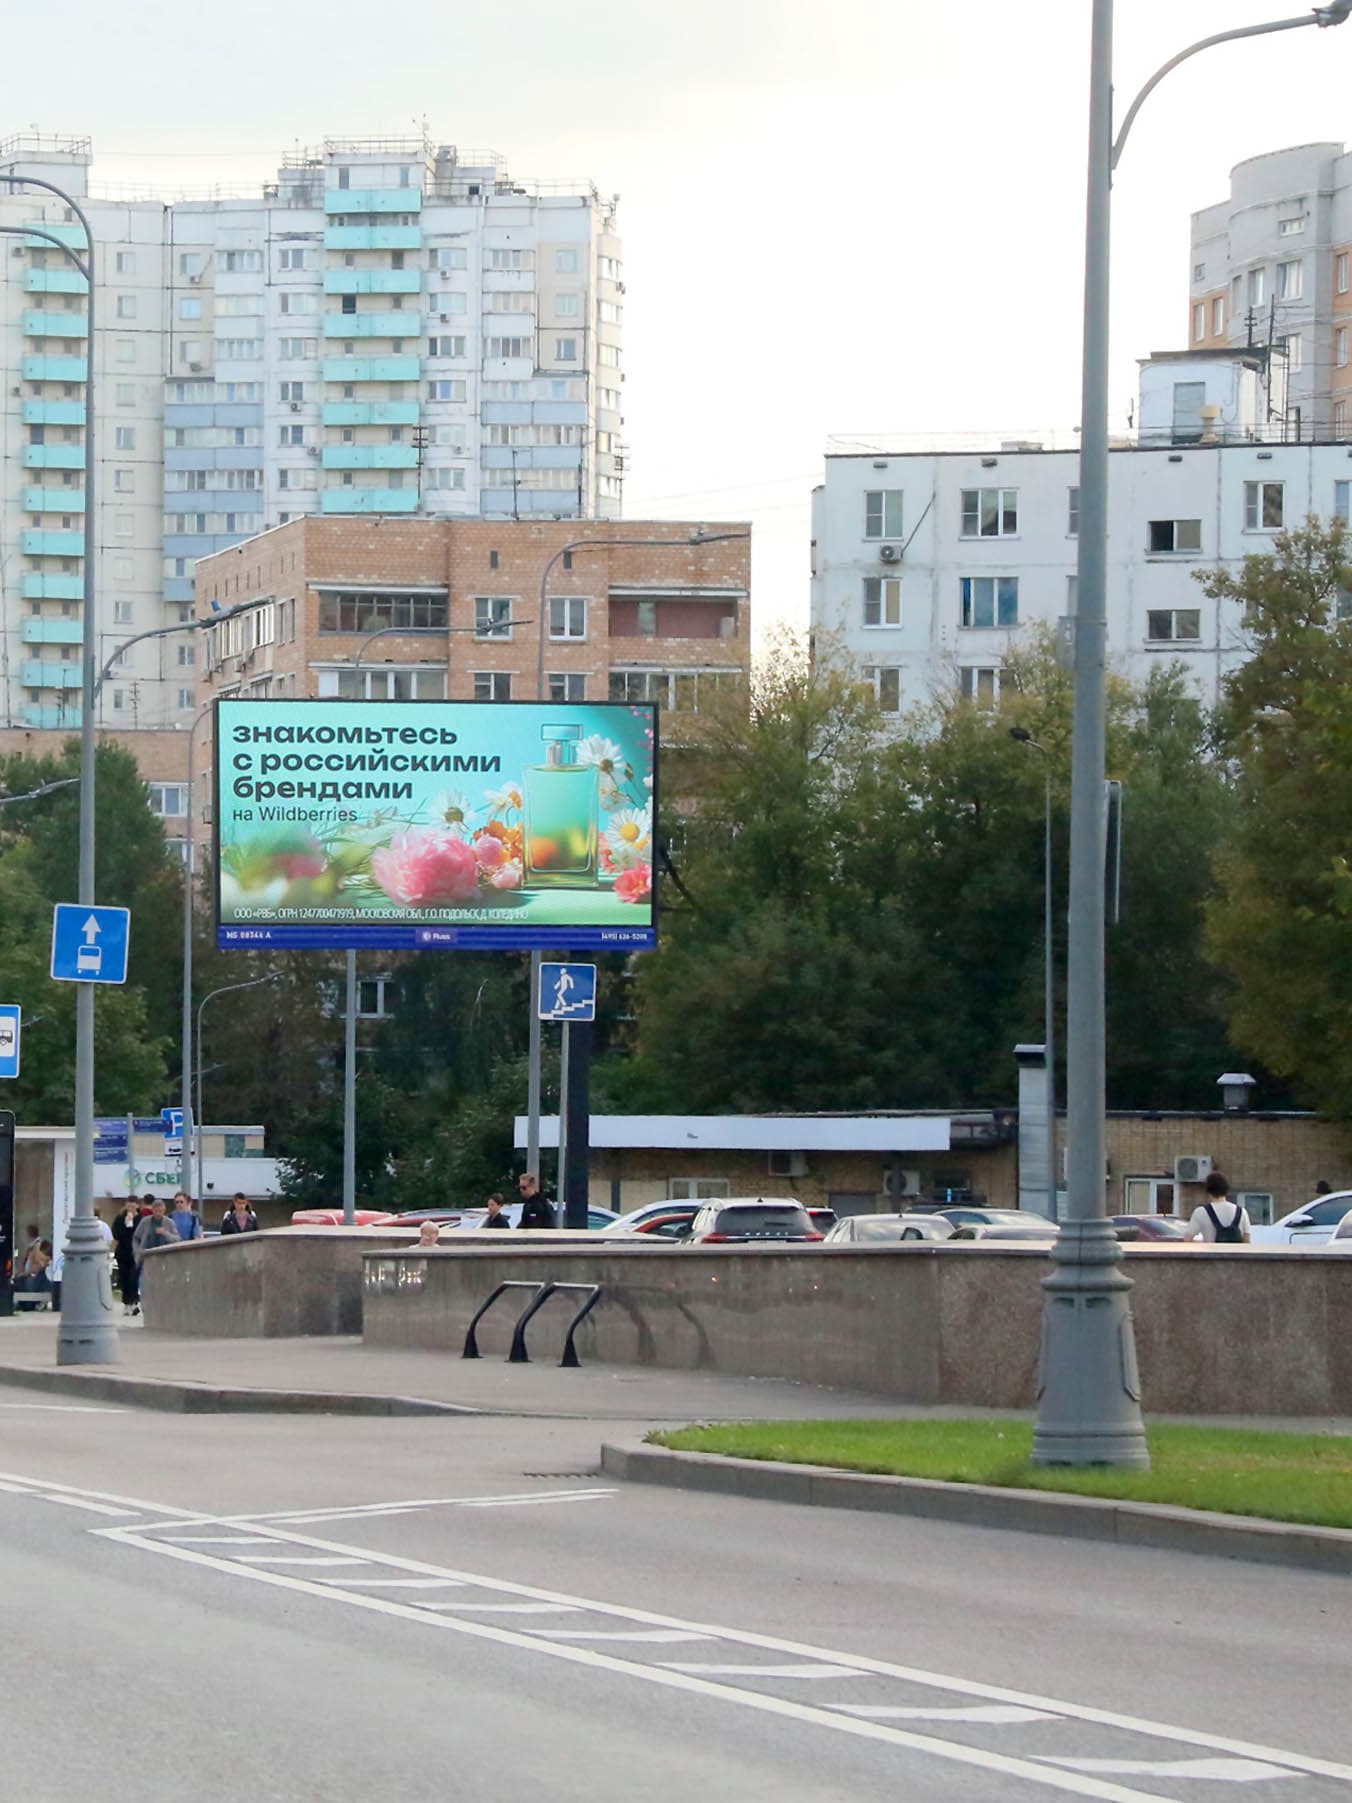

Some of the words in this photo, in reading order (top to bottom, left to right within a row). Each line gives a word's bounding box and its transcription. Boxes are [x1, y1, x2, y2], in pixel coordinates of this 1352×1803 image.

[232, 725, 458, 745] знакомьтесь
[232, 753, 253, 771] с
[260, 747, 501, 775] российскими
[232, 775, 413, 802] брендами
[232, 808, 253, 821] на
[258, 806, 358, 821] Wildberries
[233, 907, 252, 919] ООО
